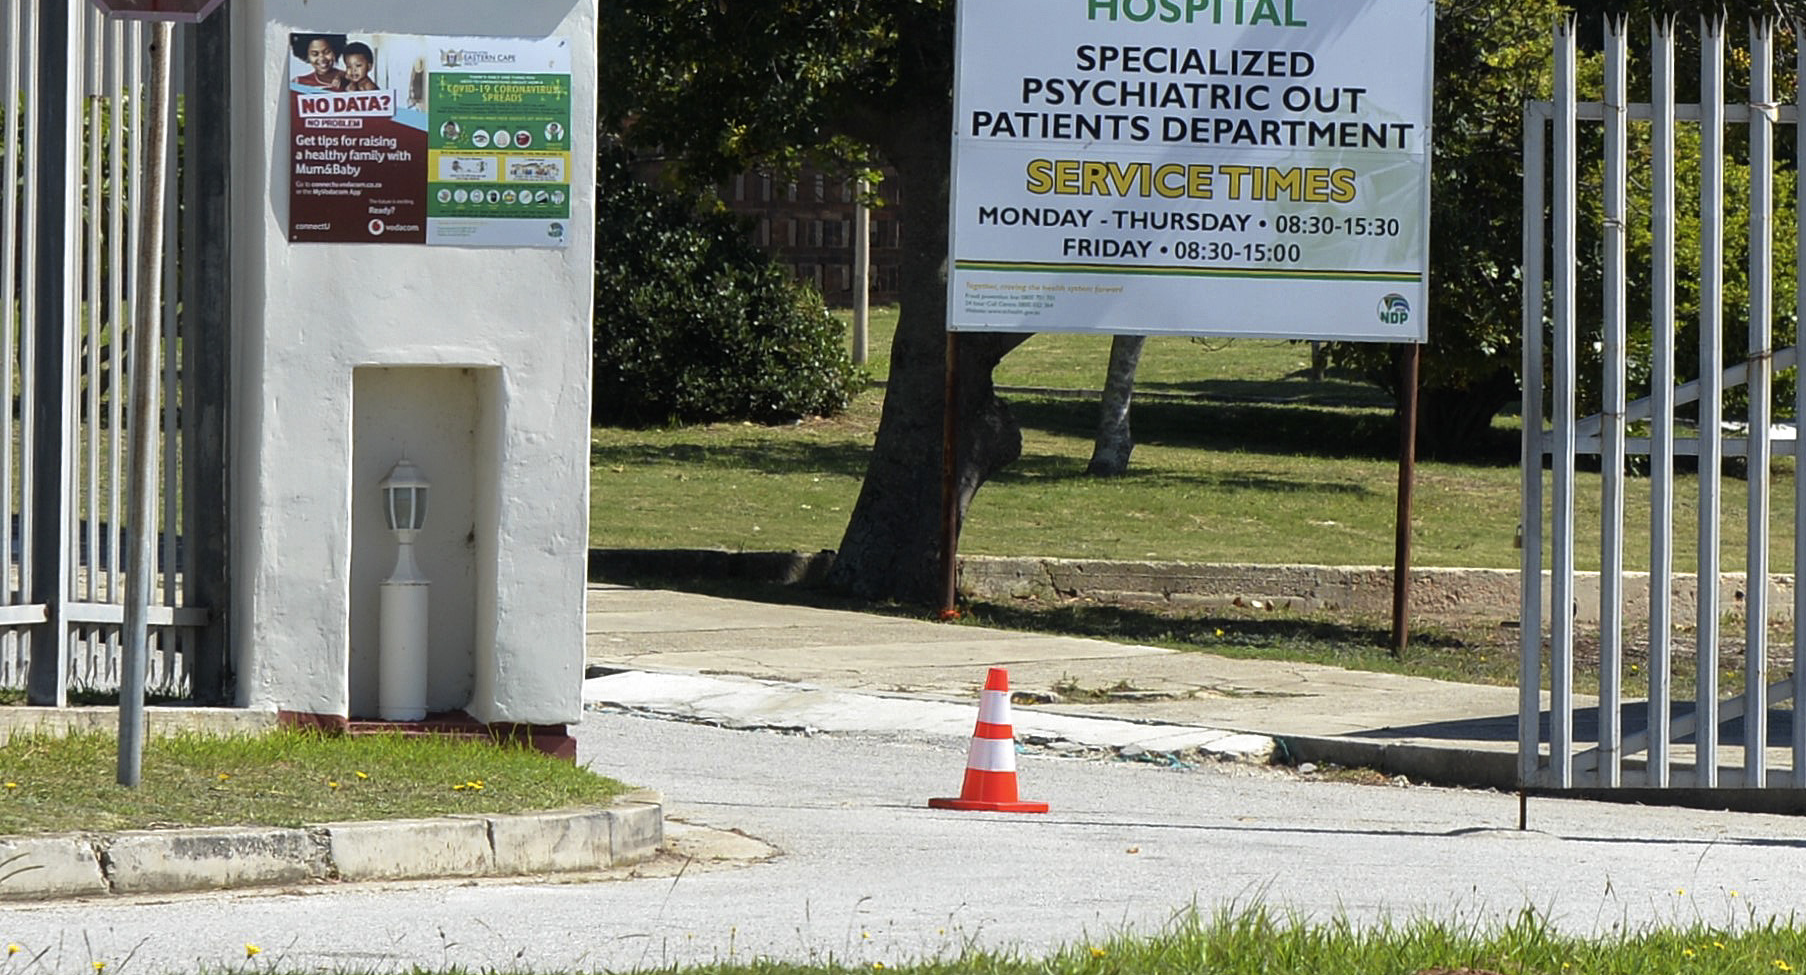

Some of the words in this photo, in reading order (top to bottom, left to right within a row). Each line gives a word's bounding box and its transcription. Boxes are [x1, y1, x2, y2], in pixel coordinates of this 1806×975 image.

[464, 54, 496, 62] EASTERN
[497, 54, 516, 62] CAPE
[1076, 45, 1315, 78] SPECIALIZED
[447, 84, 491, 93] COVID-19
[494, 85, 560, 94] CORONAVIRUS
[1022, 78, 1270, 111] PSYCHIATRIC
[1282, 86, 1366, 113] OUT
[301, 98, 330, 114] NO
[333, 95, 391, 112] DATA?
[482, 93, 522, 103] SPREADS
[322, 119, 360, 127] PROBLEM
[971, 111, 1150, 141] PATIENTS
[1162, 117, 1415, 149] DEPARTMENT
[296, 134, 316, 146] Get
[318, 135, 339, 148] tips
[341, 134, 357, 146] for
[359, 135, 397, 149] raising
[295, 152, 302, 160] a
[305, 149, 347, 163] healthy
[349, 149, 385, 163] family
[387, 150, 411, 161] with
[295, 163, 361, 177] Mum&Baby
[1026, 159, 1213, 199] SERVICE
[1219, 165, 1356, 203] TIMES
[385, 224, 419, 232] vodacom
[978, 207, 1094, 227] MONDAY
[1112, 211, 1252, 232] THURSDAY
[1275, 216, 1400, 237] 08:30-15:30
[1063, 239, 1153, 258] FRIDAY
[1174, 242, 1301, 263] 08:30-15:00
[1380, 311, 1409, 325] NDP
